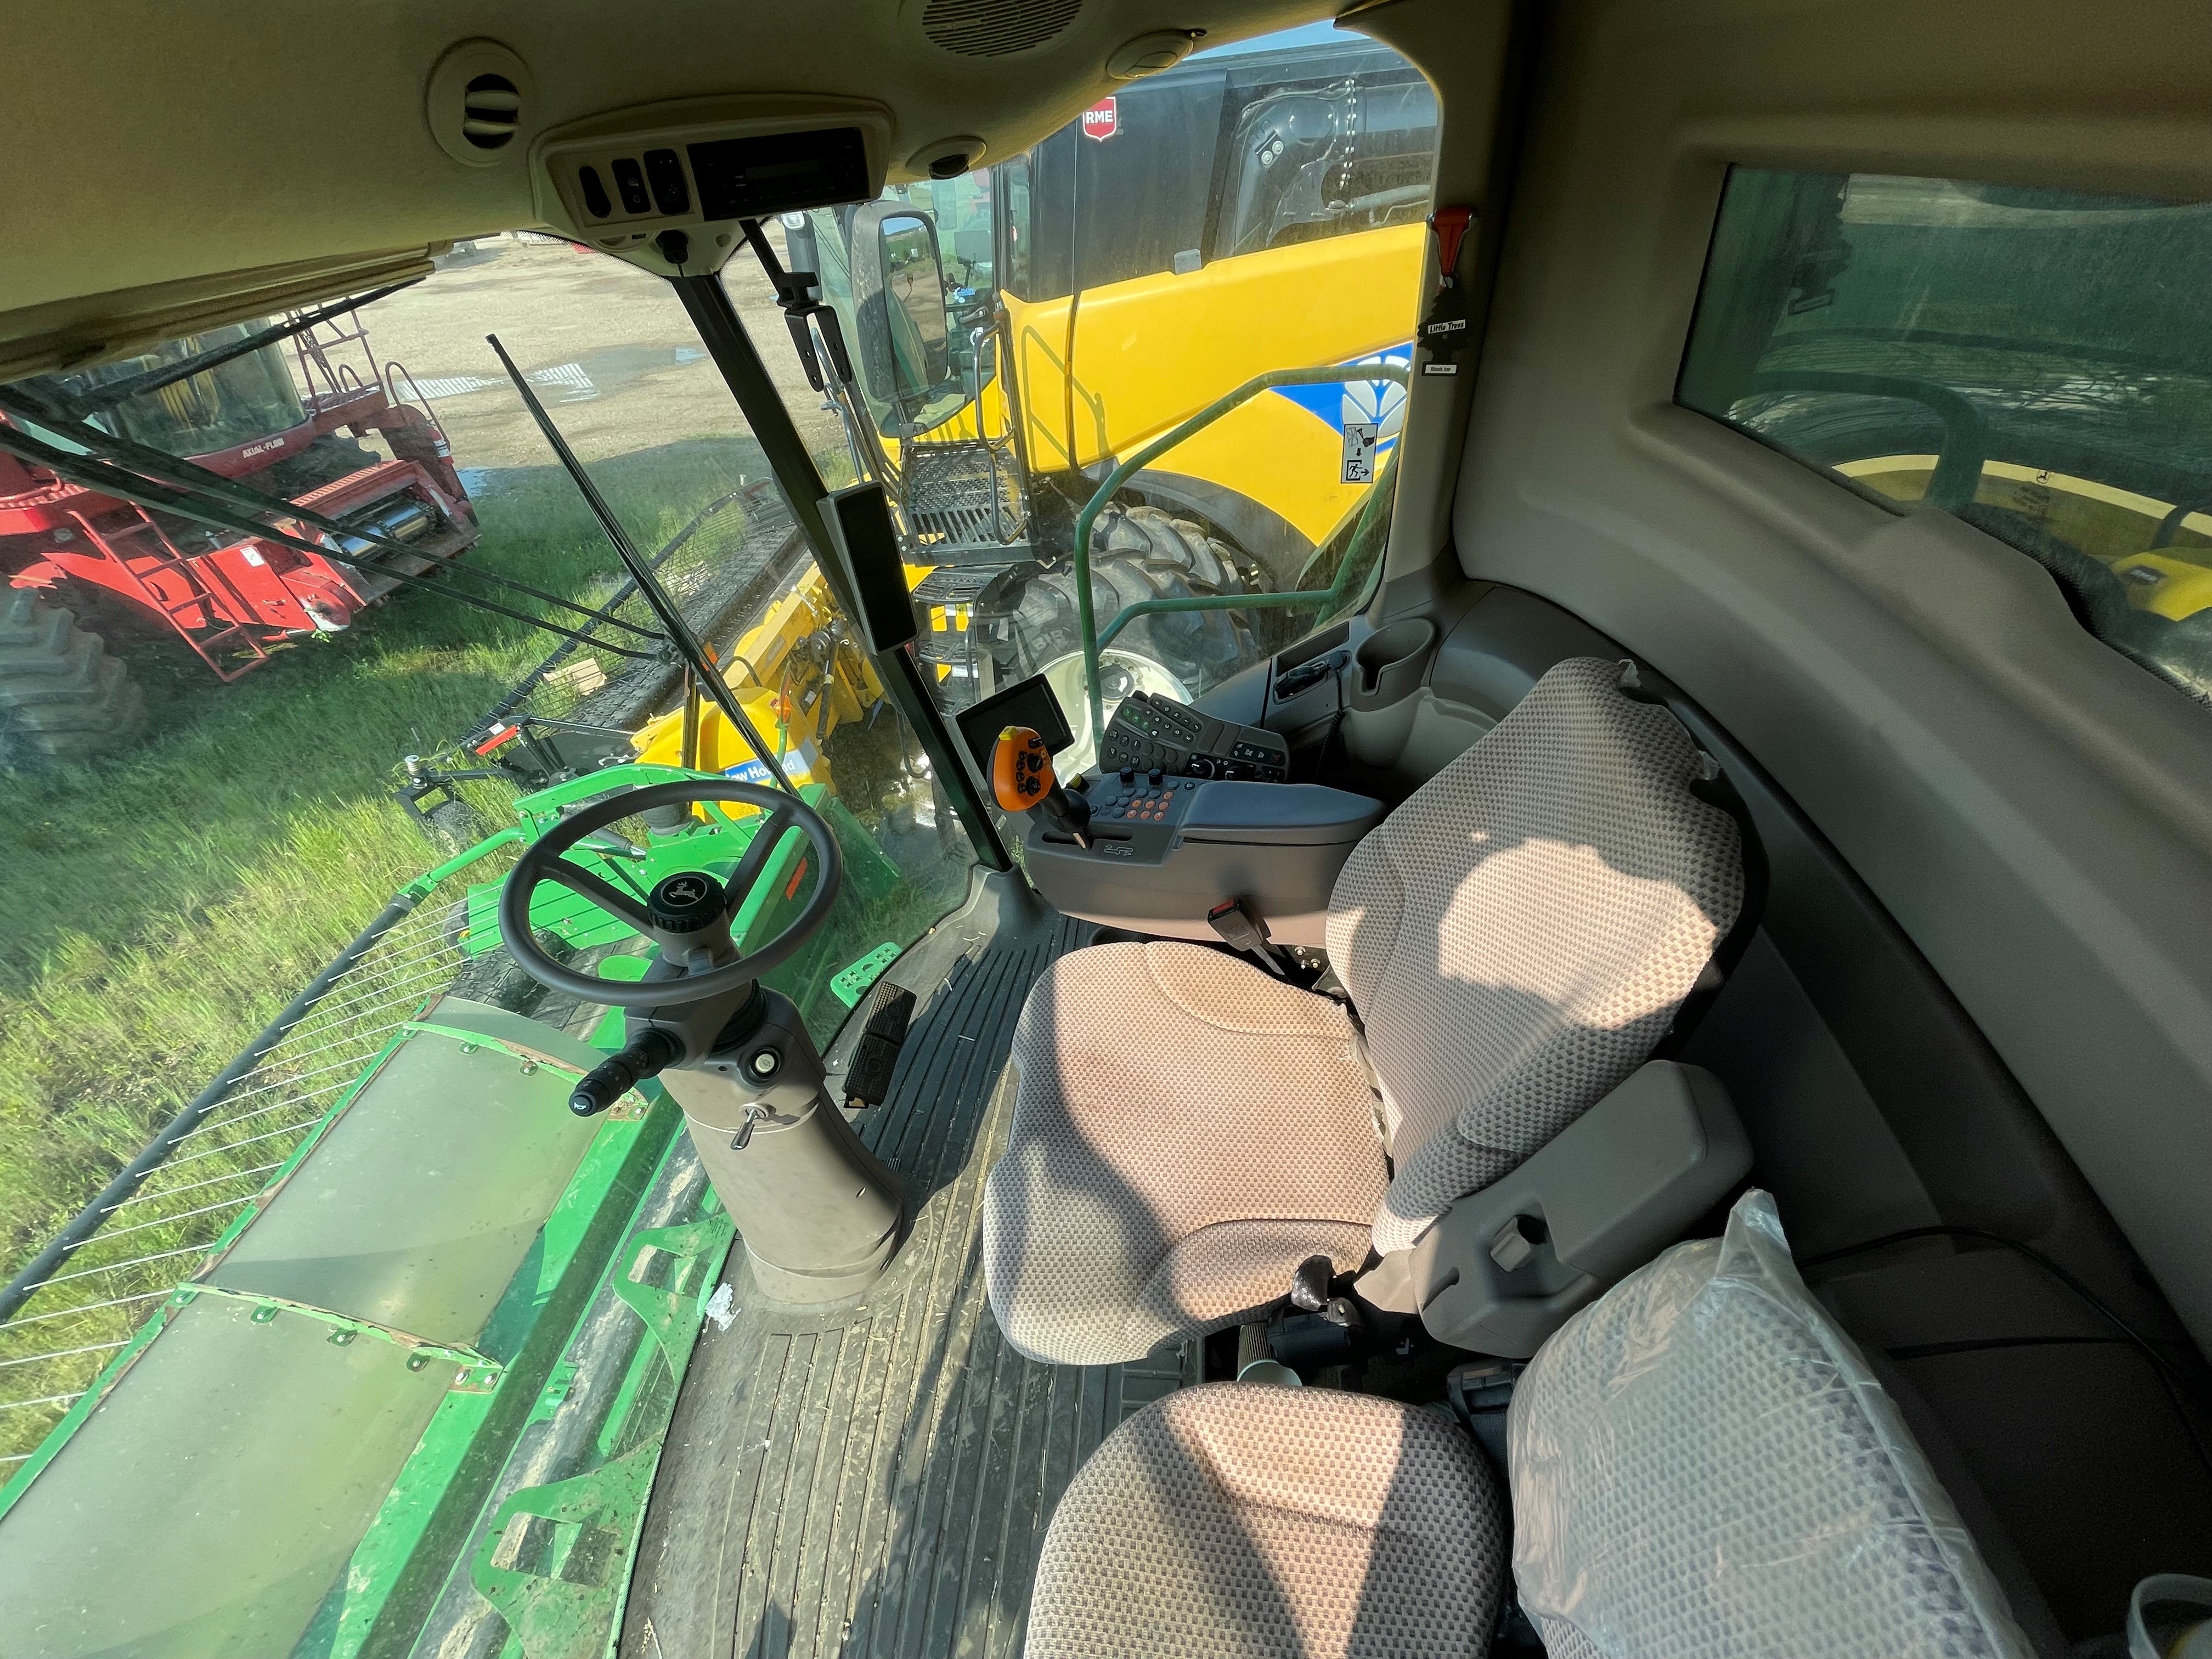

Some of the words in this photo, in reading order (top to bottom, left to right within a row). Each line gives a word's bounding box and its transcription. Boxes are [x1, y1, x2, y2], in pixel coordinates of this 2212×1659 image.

[1086, 110, 1113, 124] RME
[1430, 323, 1446, 333] Little
[747, 759, 796, 779] Hond
